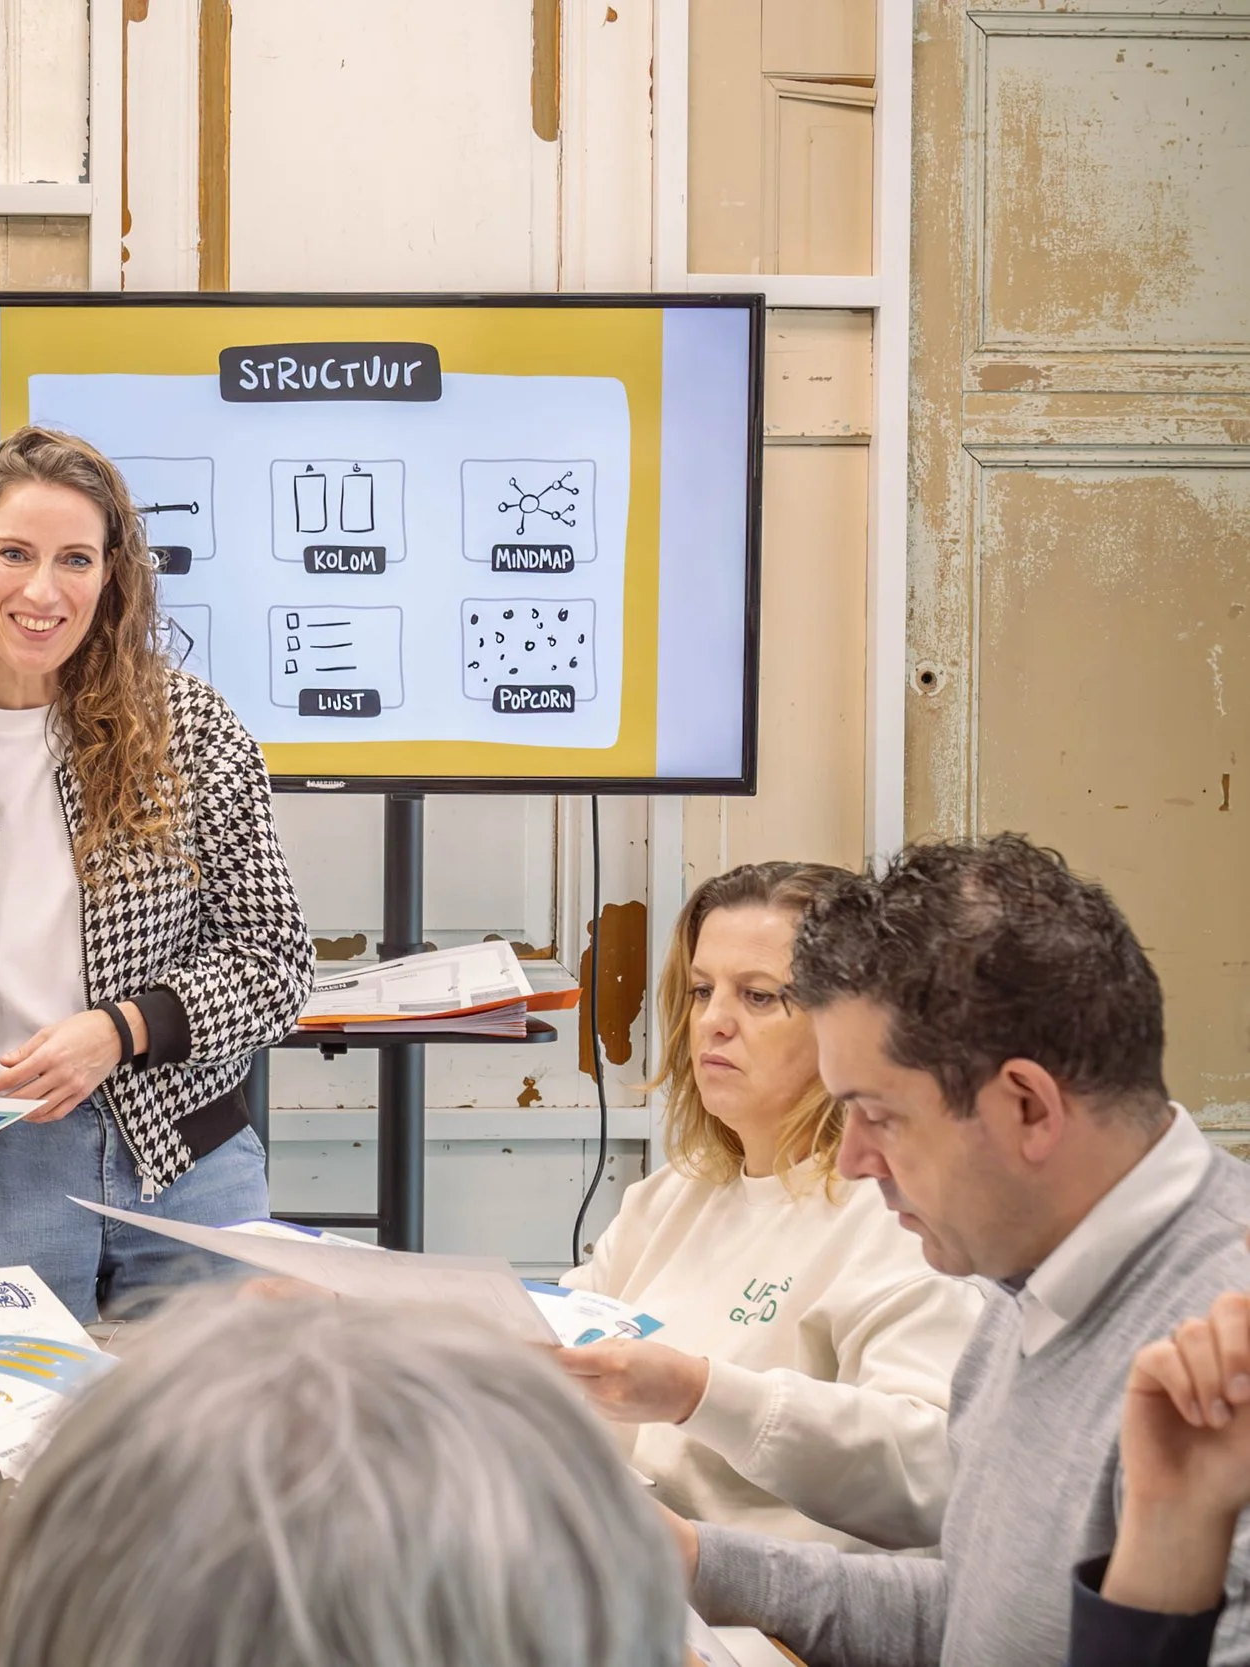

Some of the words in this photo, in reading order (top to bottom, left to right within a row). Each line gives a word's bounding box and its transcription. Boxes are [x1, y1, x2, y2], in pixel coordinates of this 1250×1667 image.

[314, 549, 377, 572] KOLOM
[496, 548, 572, 570] MINDMAP
[318, 693, 365, 711] LIJST
[500, 688, 572, 710] POPCORN
